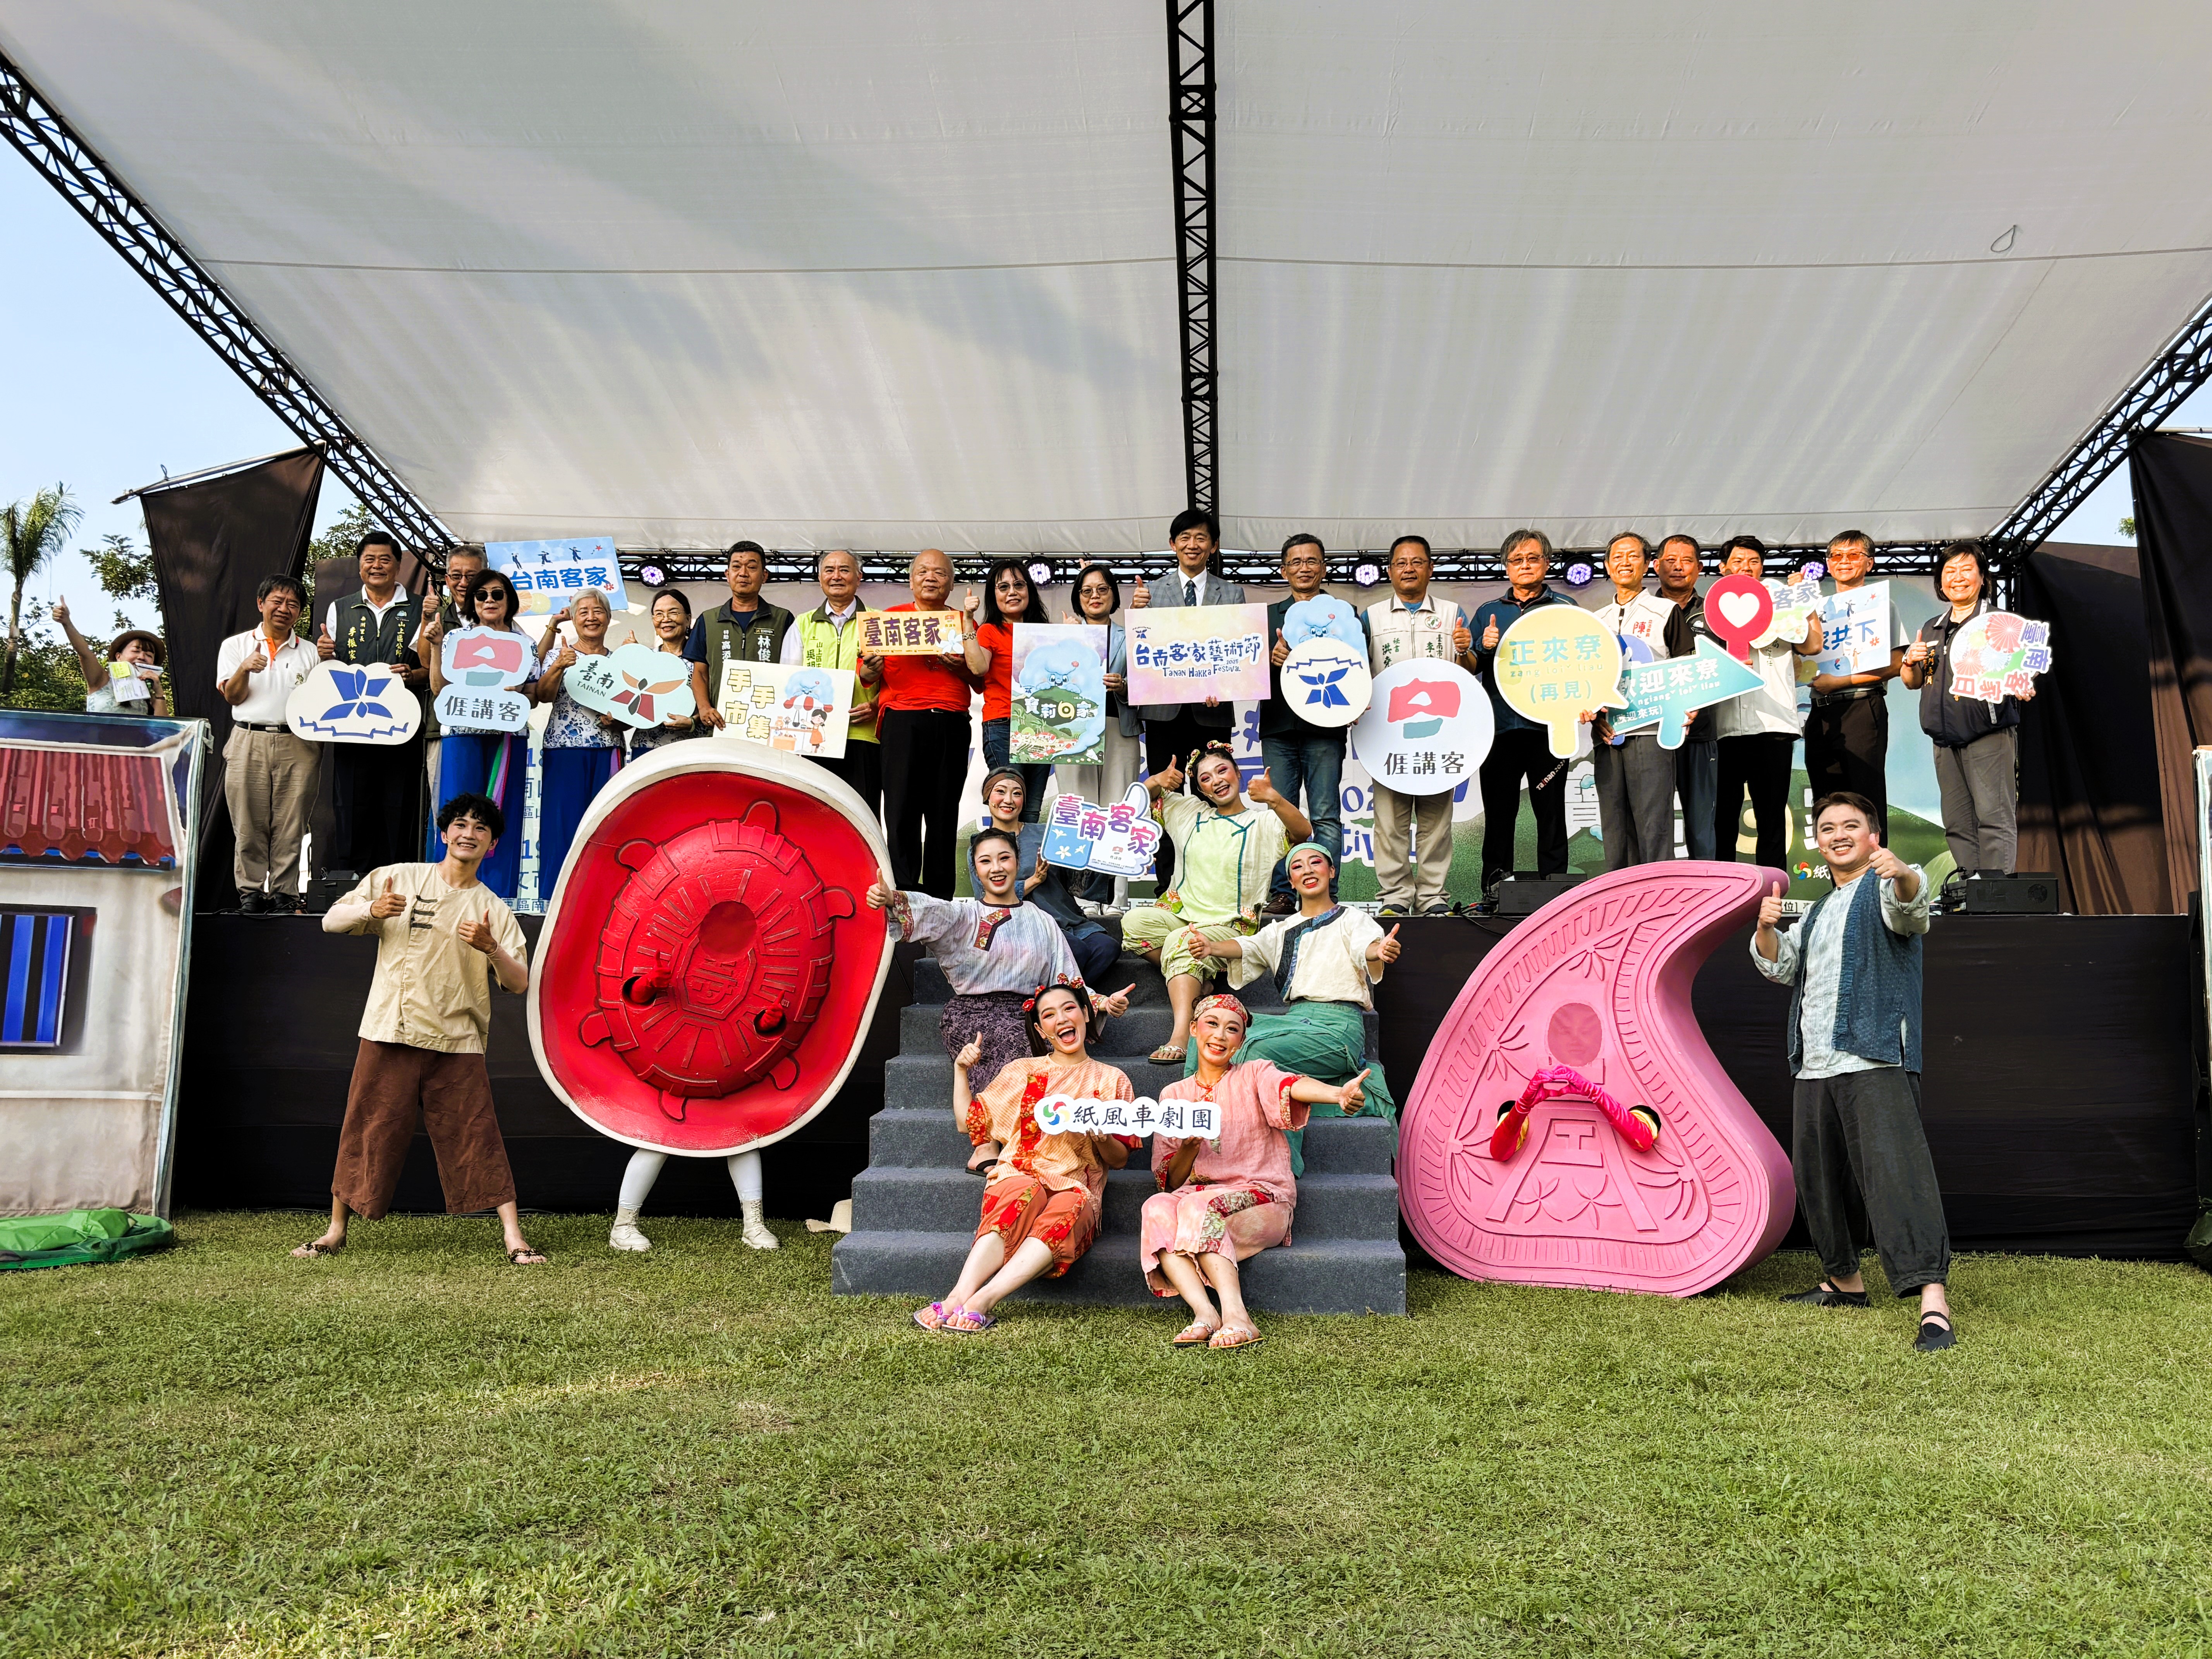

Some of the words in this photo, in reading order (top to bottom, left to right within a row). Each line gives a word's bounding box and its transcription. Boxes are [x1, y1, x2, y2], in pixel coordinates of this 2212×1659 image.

[510, 567, 611, 590] 台南客家
[1772, 582, 1819, 610] 客家
[395, 621, 405, 658] 山上區公所
[863, 617, 941, 646] 臺南客家
[1632, 621, 1646, 638] 陳
[757, 635, 771, 662] 林俊
[1135, 636, 1261, 667] 台南客家藝術節
[1425, 642, 1435, 658] 李
[580, 660, 614, 689] 臺南
[1511, 669, 1540, 677] zang
[577, 680, 606, 697] TAINAN
[1054, 796, 1156, 856] 臺南客家
[1813, 864, 1831, 880] 紙
[1073, 1104, 1212, 1130] 紙風車劇團
